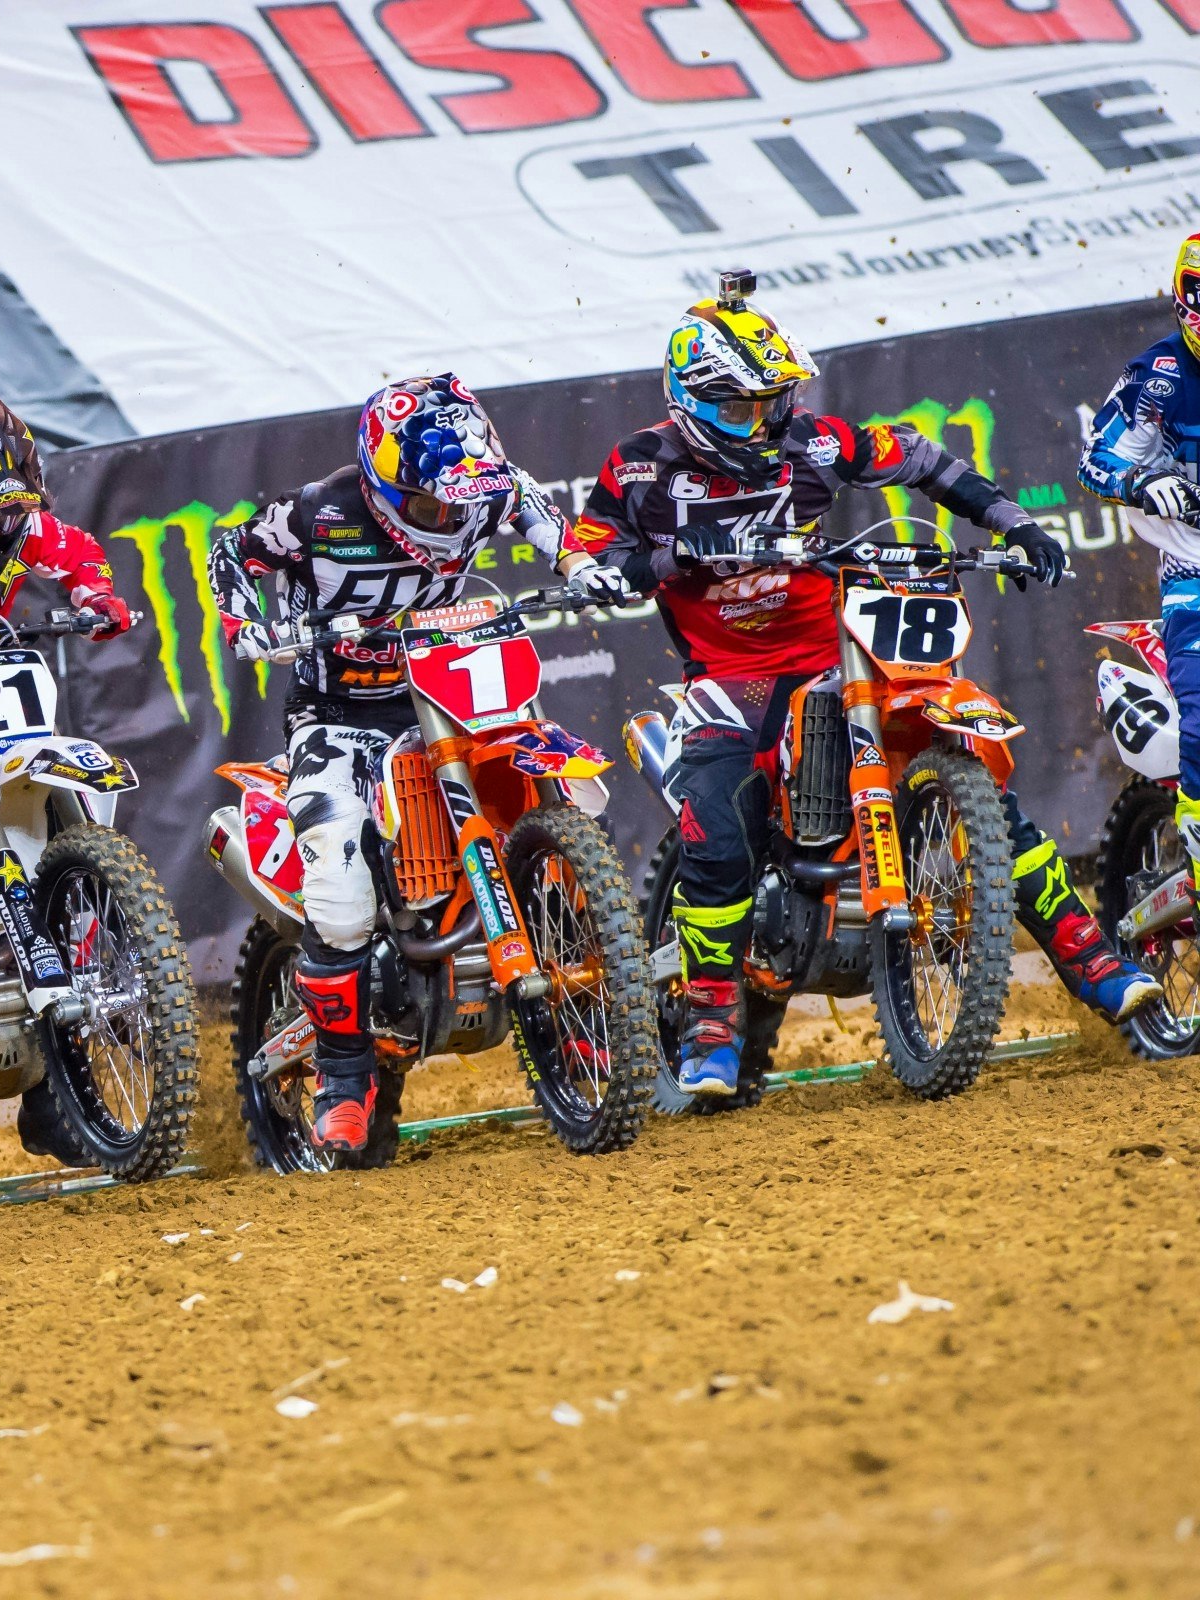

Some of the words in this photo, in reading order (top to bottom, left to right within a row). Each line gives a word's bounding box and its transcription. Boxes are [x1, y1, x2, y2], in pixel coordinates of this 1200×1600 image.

[573, 79, 1200, 234] TIRE
[444, 480, 480, 500] Red
[480, 475, 513, 494] Bull
[329, 546, 372, 557] MOTOREX
[859, 596, 958, 664] 18
[448, 644, 509, 715] 1
[1105, 681, 1170, 755] 19
[908, 769, 939, 791] PIRELLI
[858, 806, 881, 891] GALFER
[470, 872, 501, 938] MOTOREX
